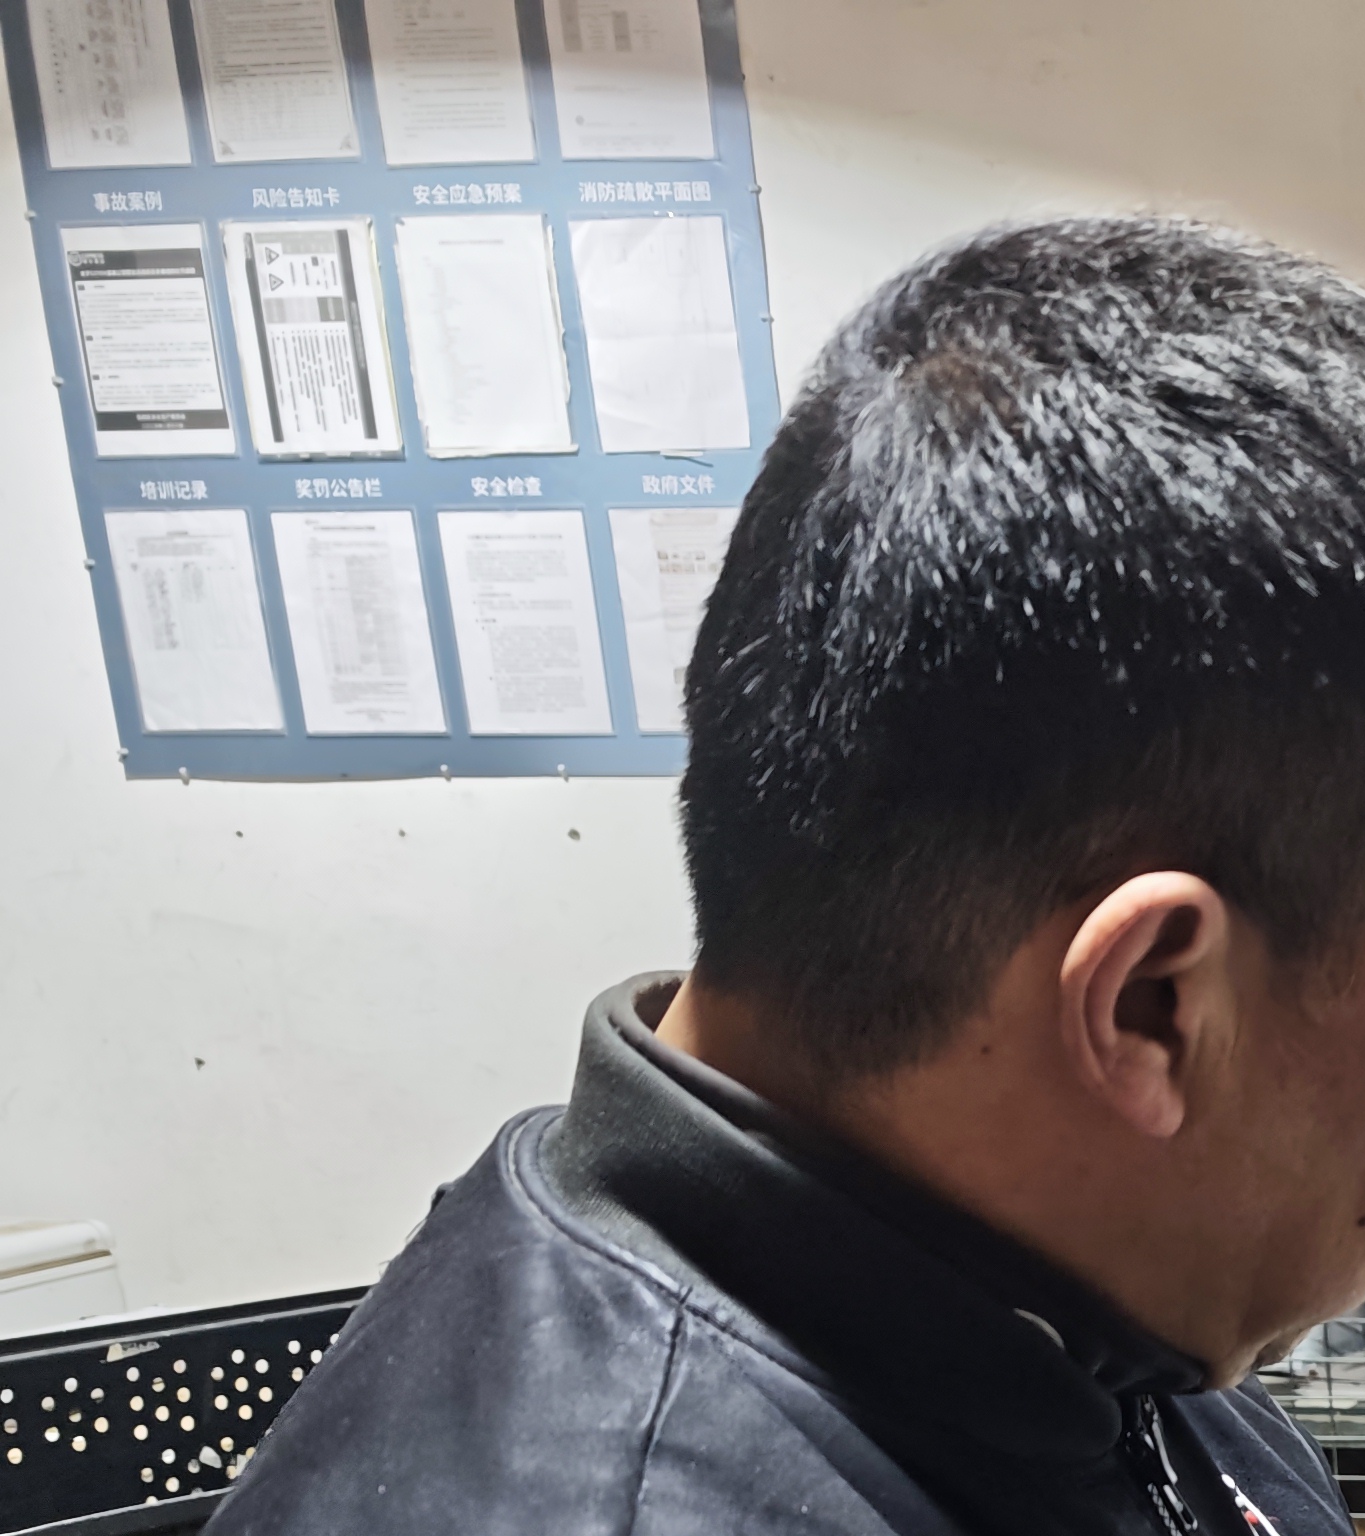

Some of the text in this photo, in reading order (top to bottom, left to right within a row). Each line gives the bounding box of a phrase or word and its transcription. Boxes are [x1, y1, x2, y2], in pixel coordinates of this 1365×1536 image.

[93, 190, 163, 212] 事故案例
[252, 188, 341, 208] 风险告知卡
[412, 182, 523, 205] 安全应急预案
[578, 180, 711, 203] 消防疏散平面图
[140, 480, 208, 500] 培训记录
[295, 478, 382, 498] 奖罚公告栏
[470, 476, 543, 497] 安全检查
[641, 475, 716, 495] 政府文件
